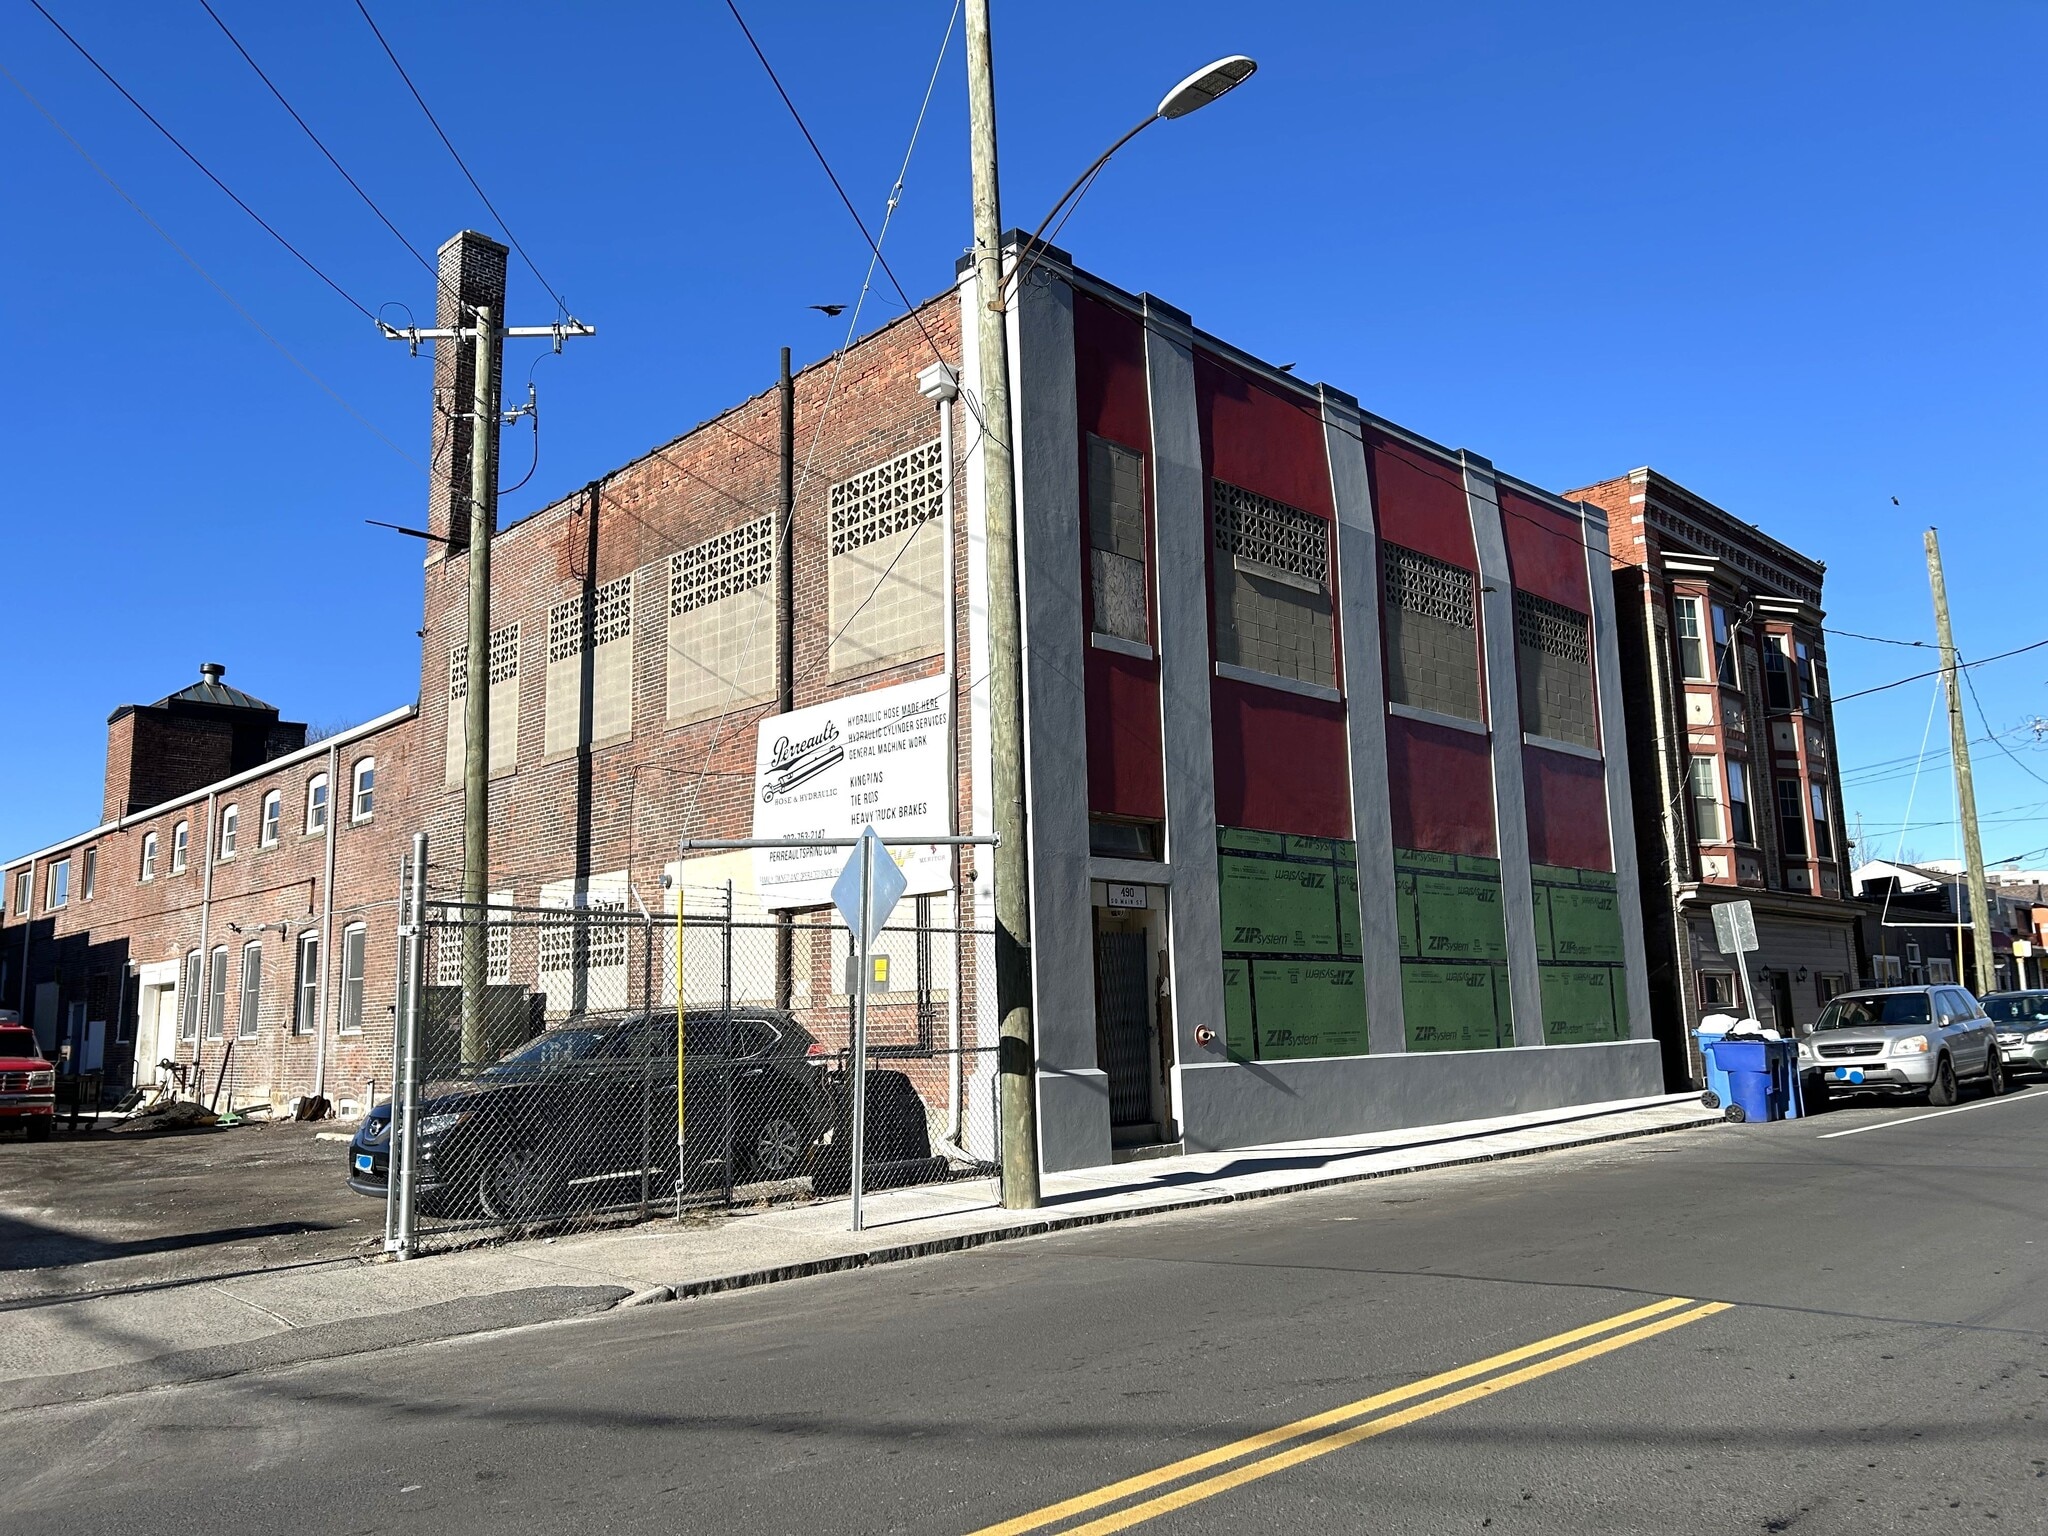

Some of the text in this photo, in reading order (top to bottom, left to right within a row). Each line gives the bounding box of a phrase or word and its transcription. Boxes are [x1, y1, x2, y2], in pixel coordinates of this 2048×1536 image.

[848, 698, 939, 727] HYDRAULIC HOSE MADE HERE
[848, 713, 947, 743] HYDRAULIC CYLINDER SERVICES
[771, 720, 837, 767] Perreault
[849, 735, 927, 760] GENERAL MACHINE WORK
[850, 771, 883, 788] KINGPINS
[775, 796, 792, 806] HOSE
[800, 788, 838, 802] HYDRAULIC
[850, 794, 861, 806] TIE
[851, 810, 874, 825] HEAVY
[899, 802, 927, 818] BRAKES
[1120, 887, 1135, 898] 490
